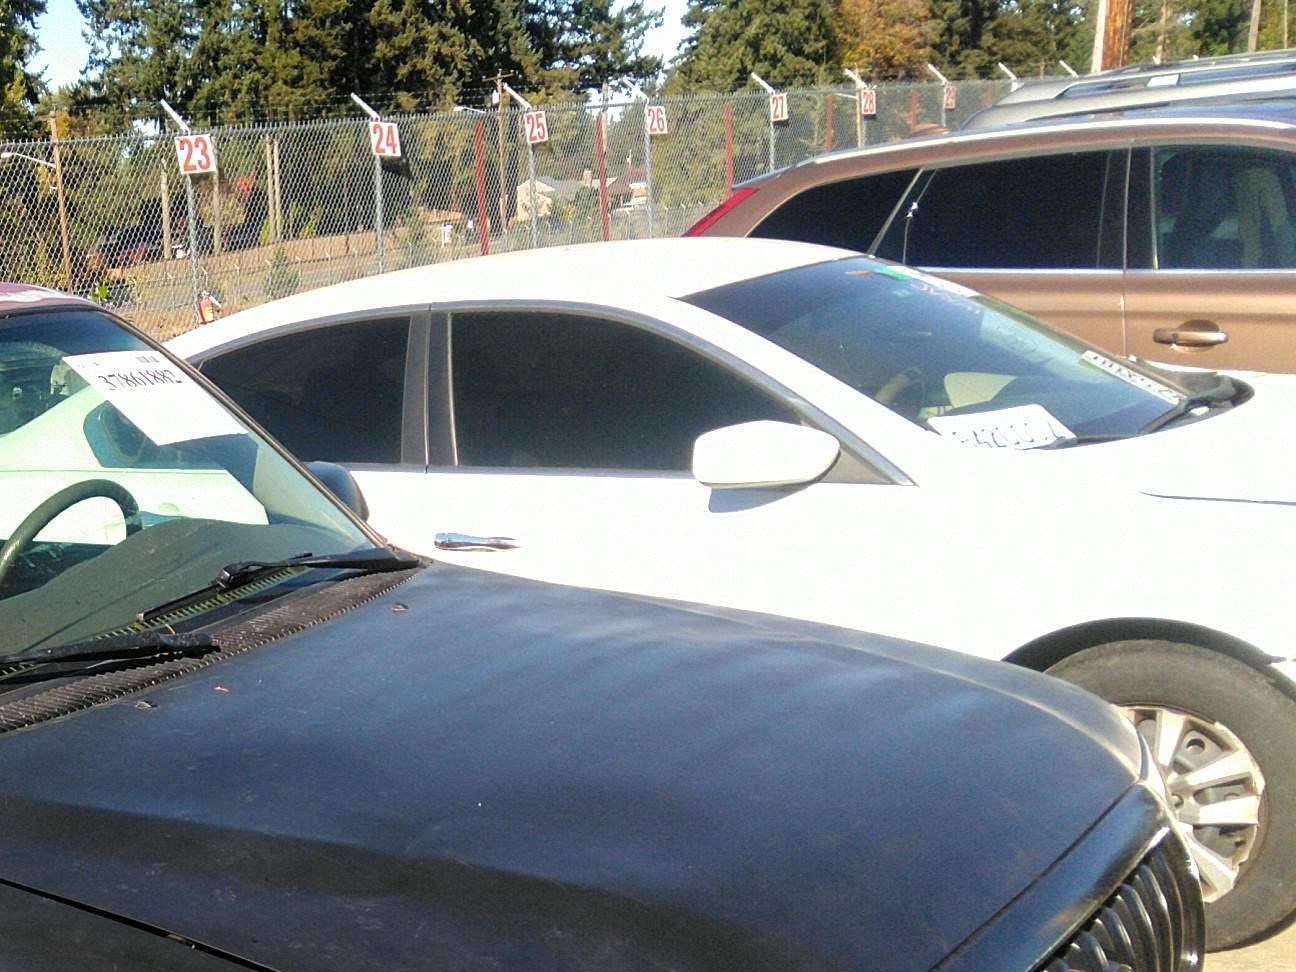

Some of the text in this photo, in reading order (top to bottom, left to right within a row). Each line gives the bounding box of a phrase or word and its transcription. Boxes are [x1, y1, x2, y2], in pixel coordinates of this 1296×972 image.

[647, 107, 665, 132] 26
[772, 96, 785, 119] 27
[372, 123, 398, 154] 24
[526, 113, 546, 142] 25
[179, 136, 212, 172] 23
